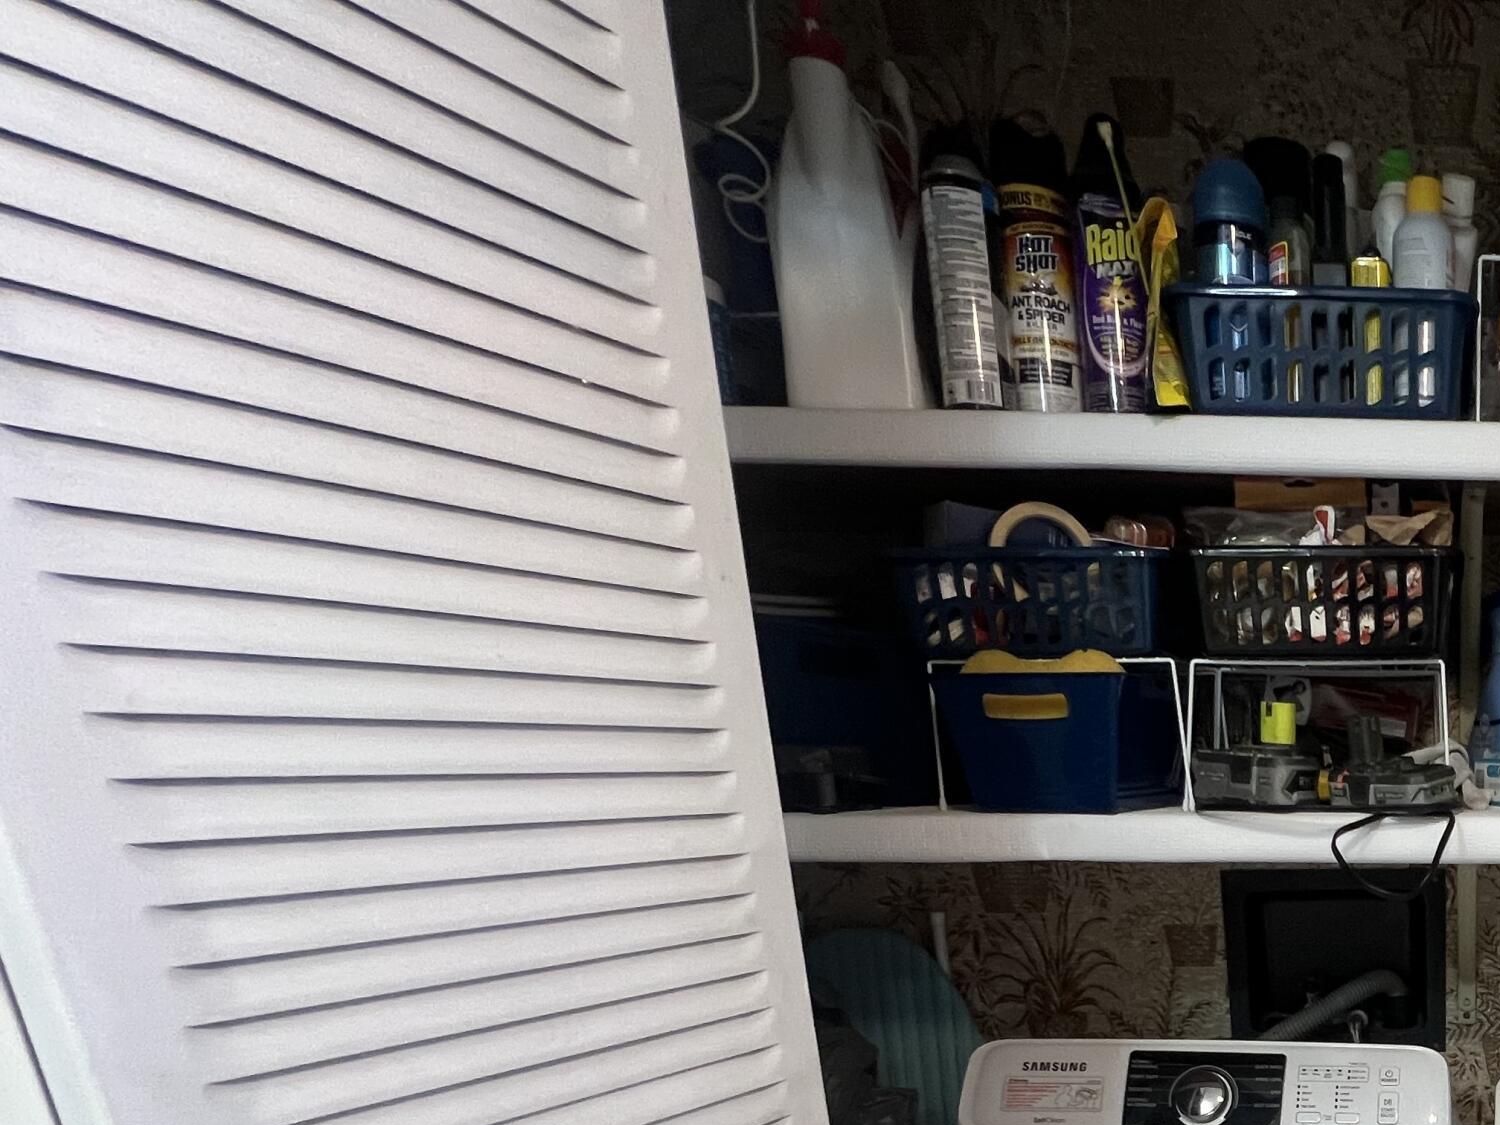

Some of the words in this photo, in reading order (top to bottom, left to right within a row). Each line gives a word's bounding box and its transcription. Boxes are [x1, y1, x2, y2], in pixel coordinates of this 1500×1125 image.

[1018, 235, 1053, 254] HOT
[1086, 221, 1139, 266] Raid
[1015, 255, 1058, 273] SHOT
[1096, 261, 1135, 279] MAX
[1034, 296, 1071, 314] ROACH
[1018, 311, 1024, 320] &
[1026, 308, 1066, 324] SPIDER
[1022, 1061, 1087, 1072] SAMSUNG
